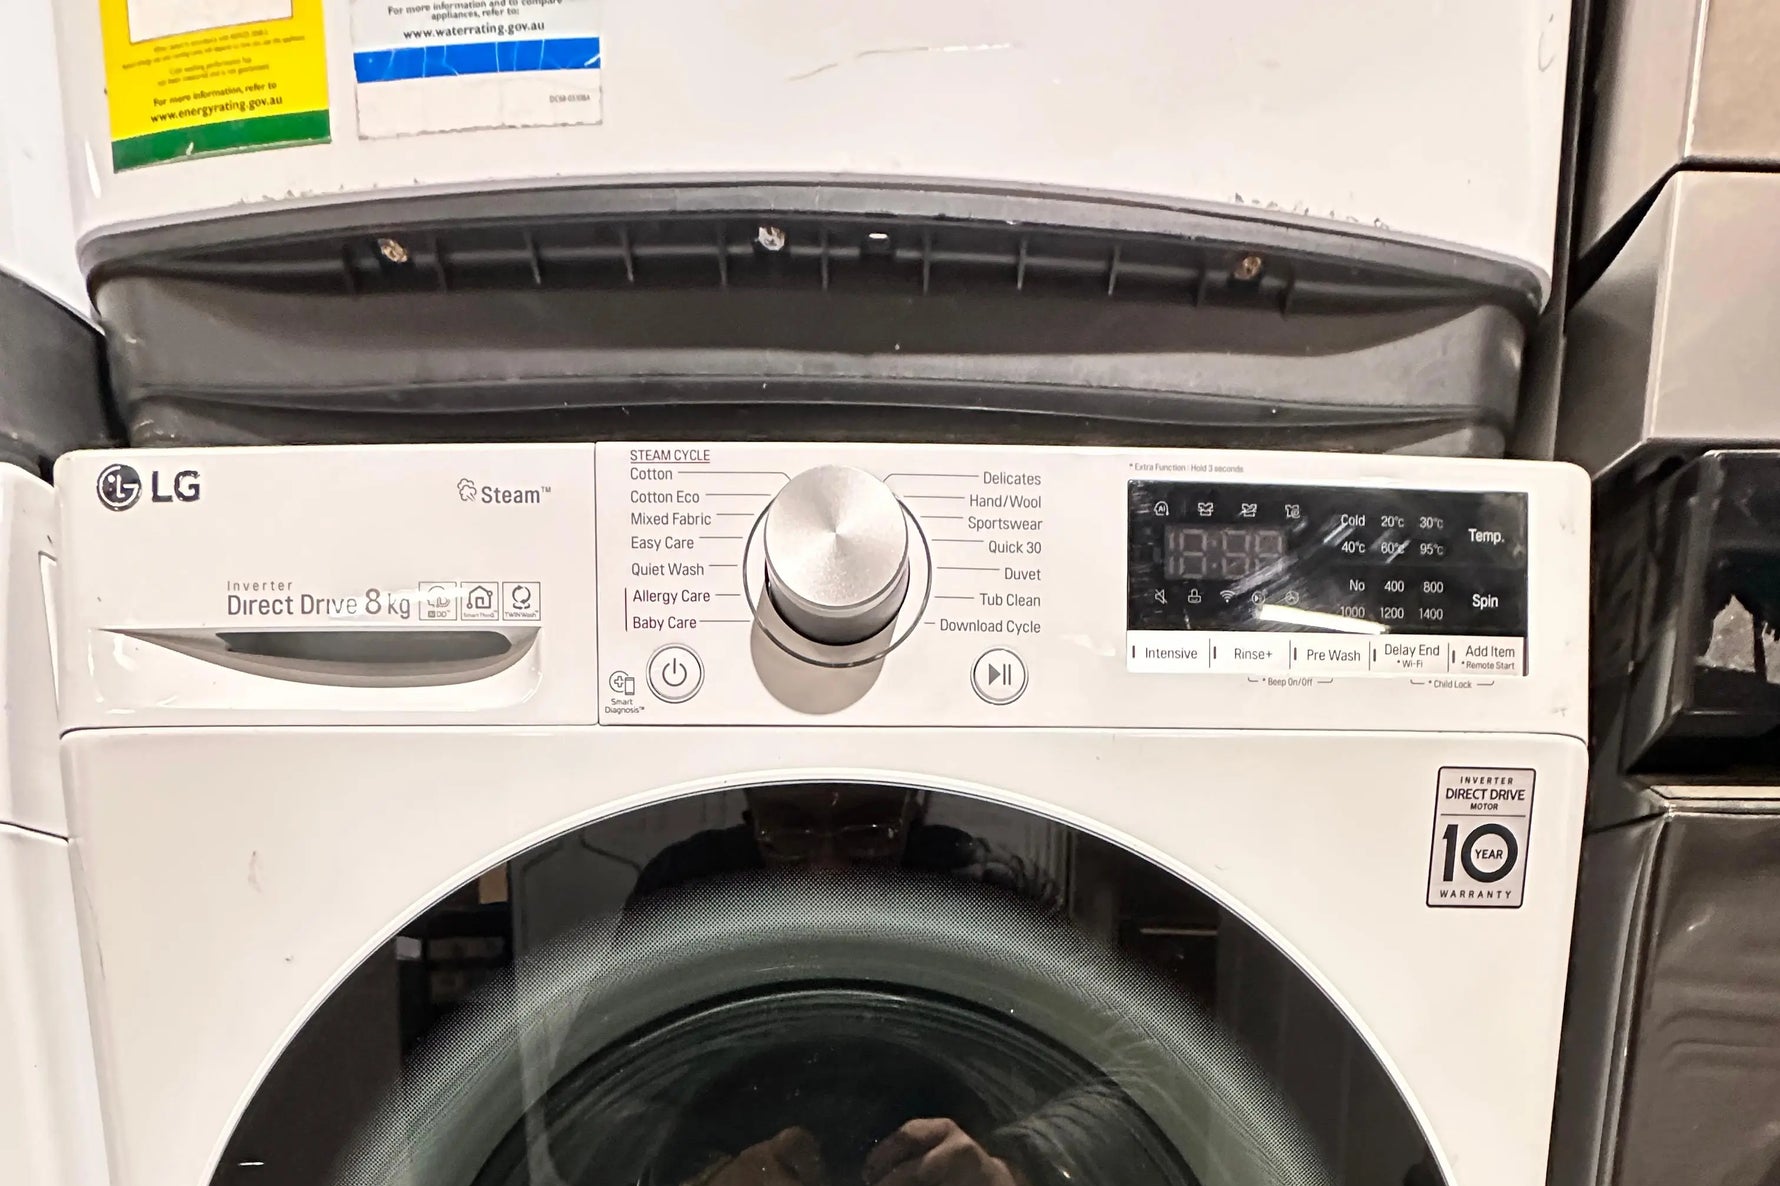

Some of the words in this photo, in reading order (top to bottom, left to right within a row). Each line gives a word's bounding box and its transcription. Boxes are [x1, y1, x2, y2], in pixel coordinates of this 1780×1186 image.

[388, 6, 403, 16] For
[406, 4, 431, 13] more
[482, 8, 504, 17] refer
[403, 21, 545, 39] www.waterrating.gov.au
[153, 97, 167, 107] For
[245, 82, 265, 92] refer
[268, 81, 277, 90] to
[150, 95, 283, 124] www.energyrating.gov.au
[630, 450, 671, 461] STEAM
[674, 450, 710, 461] CYCLE
[630, 467, 673, 480] Cotton
[1135, 463, 1153, 472] Extra
[1190, 464, 1207, 473] Hold
[1214, 465, 1244, 473] seconds
[983, 471, 1041, 486] Delicates
[152, 470, 200, 502] LG
[630, 490, 673, 503] Cotton
[676, 491, 700, 503] Eco
[970, 494, 1041, 508] Hand/Wool
[631, 512, 669, 525] Mixed
[672, 512, 712, 526] Fabric
[968, 516, 1043, 532] Sportswear
[1340, 514, 1366, 527] Cold
[1468, 528, 1505, 545] Temp.
[631, 536, 661, 551] Easy
[665, 536, 694, 549] Care
[988, 540, 1023, 554] Quick
[1026, 542, 1042, 554] 30
[631, 563, 665, 576] Quiet
[668, 563, 704, 576] Wash
[1004, 567, 1041, 580] Duvet
[227, 580, 293, 592] Inverter
[1349, 579, 1366, 592] No
[1384, 580, 1405, 592] 400
[1423, 581, 1444, 593] 800
[228, 594, 294, 616] Direct
[300, 594, 358, 616] Drive
[364, 588, 383, 615] 8
[387, 592, 412, 619] kg
[633, 589, 678, 605] Allergy
[681, 590, 711, 602] Care
[979, 593, 1003, 606] Tub
[1006, 593, 1041, 607] Clean
[1472, 594, 1499, 610] Spin
[1340, 606, 1366, 618] 1000
[1380, 606, 1405, 619] 1200
[1419, 608, 1444, 620] 1400
[633, 616, 665, 631] Baby
[668, 616, 697, 629] Care
[940, 618, 1003, 632] Download
[1006, 620, 1041, 635] Cycle
[1145, 647, 1198, 660] Intensive
[1234, 648, 1273, 660] Rinse+
[1307, 649, 1326, 661] Pre
[1329, 650, 1361, 662] Wash
[1384, 643, 1416, 657] Delay
[1420, 644, 1440, 656] End
[1465, 645, 1488, 657] Add
[1491, 646, 1515, 658] Item
[1403, 660, 1423, 668] Wi-Fi
[1466, 662, 1494, 670] Remote
[1496, 662, 1515, 670] Start
[1268, 677, 1286, 687] Beep
[1288, 678, 1313, 687] On/Off
[1434, 679, 1453, 688] Child
[1454, 680, 1472, 689] Lock
[1460, 776, 1514, 785] INVERTER
[1445, 788, 1488, 800] DIRECT
[1490, 789, 1526, 801] DRIVE
[1470, 803, 1499, 811] MOTOR
[1442, 823, 1519, 883] 10
[1475, 849, 1503, 859] YEAR
[1440, 890, 1512, 898] WARRANTY
